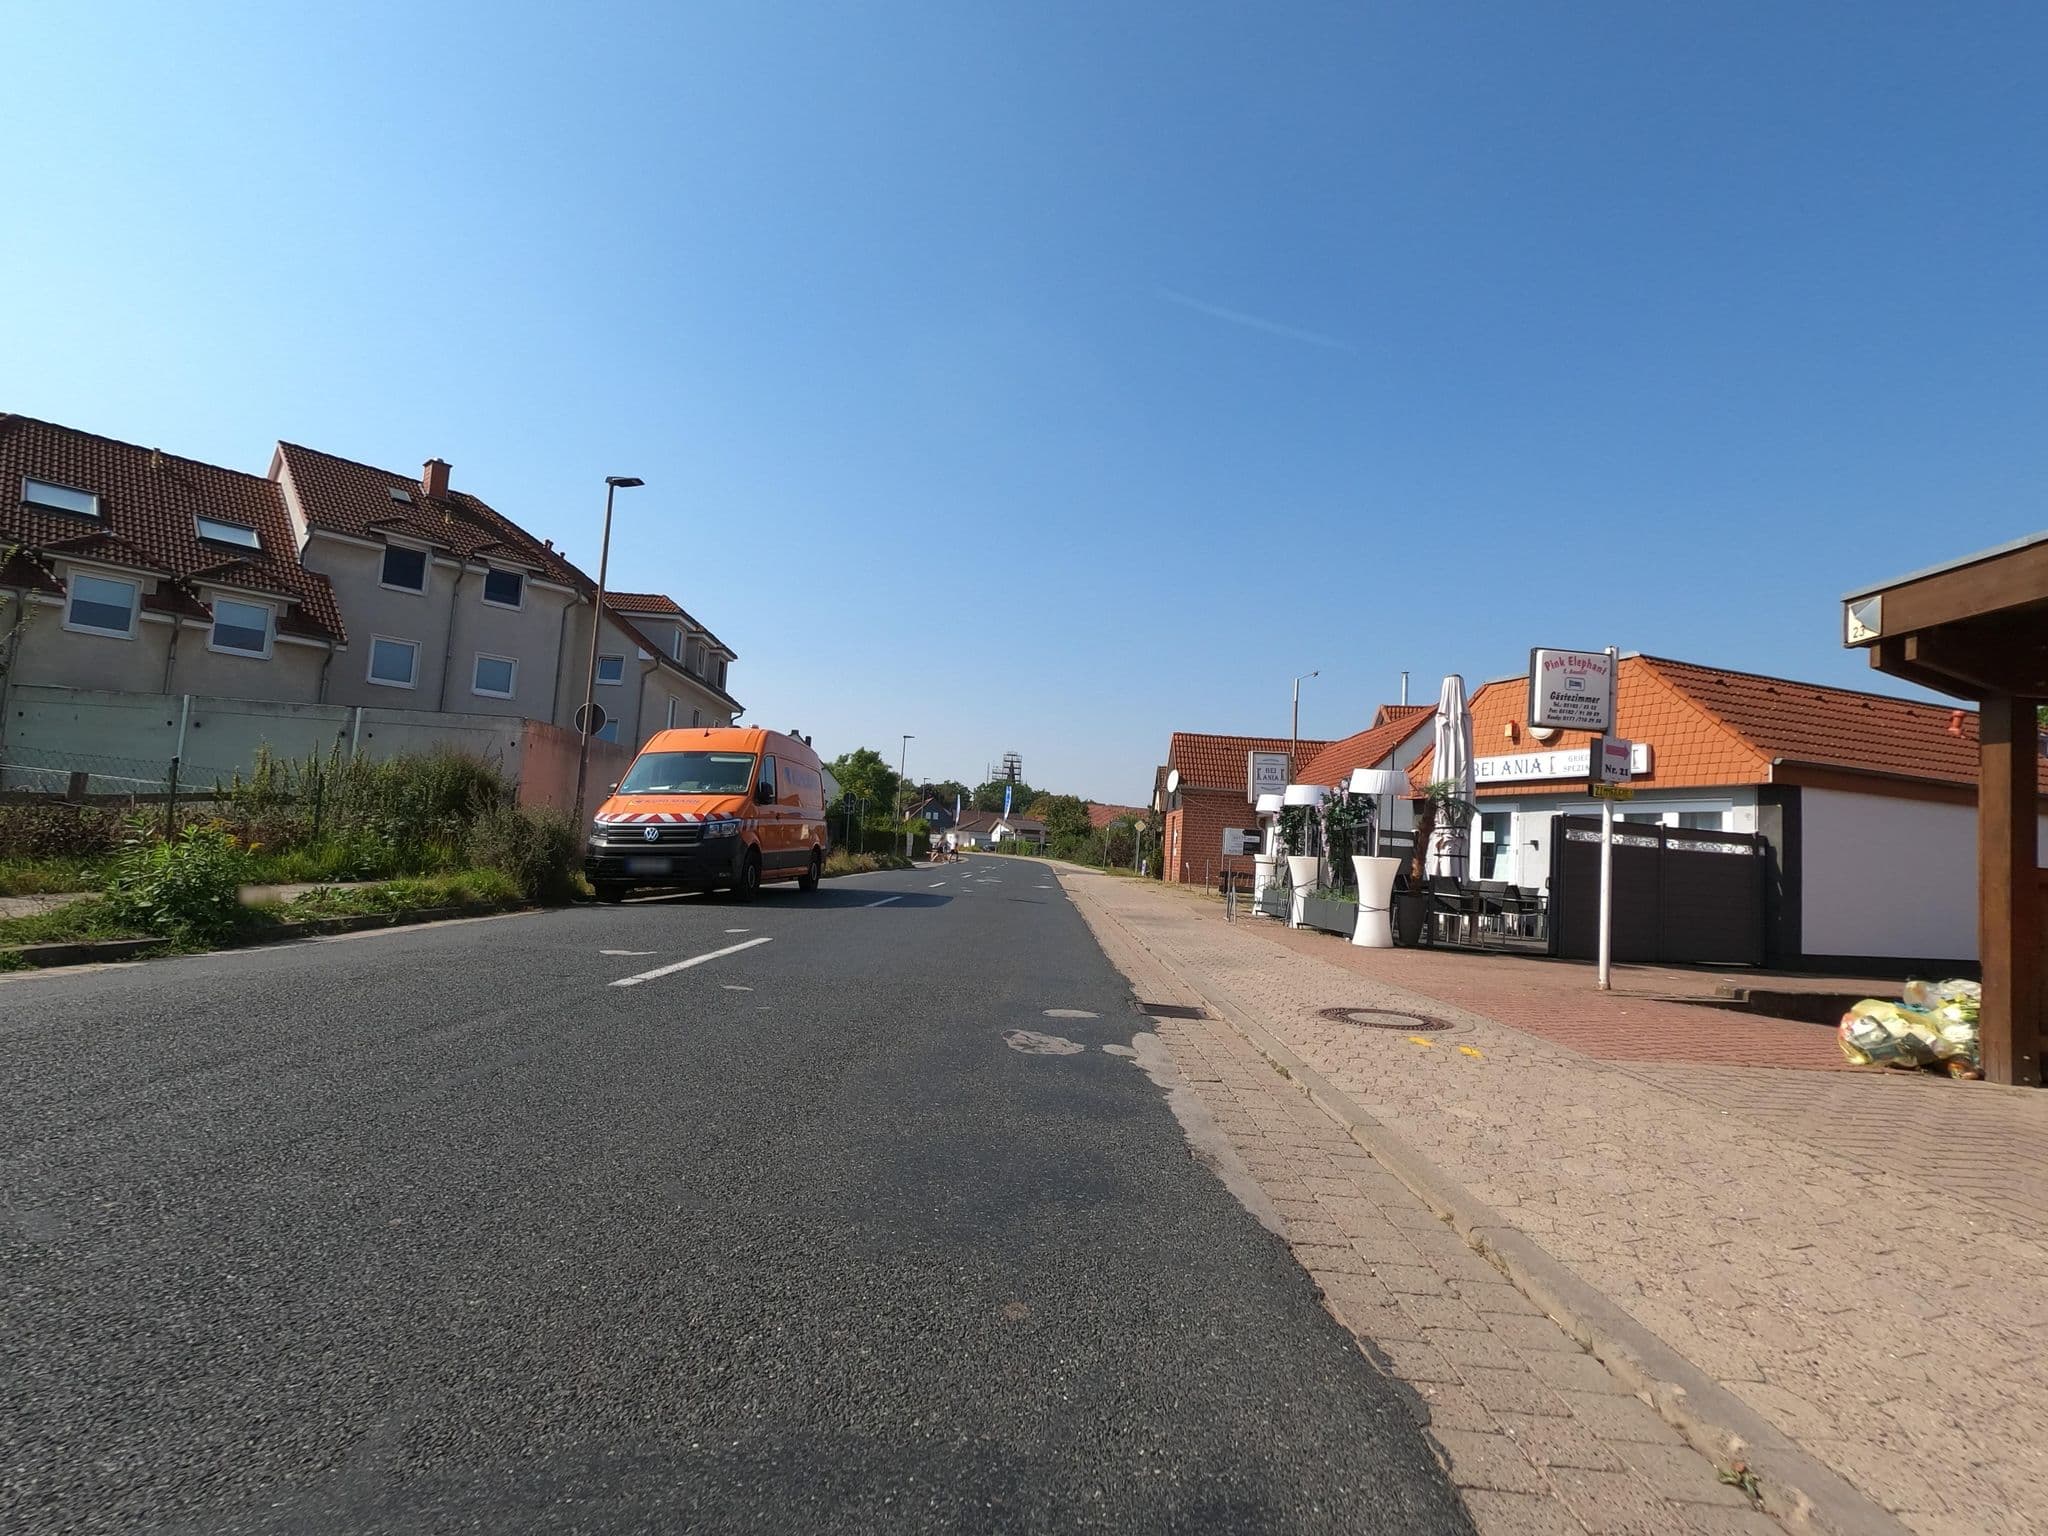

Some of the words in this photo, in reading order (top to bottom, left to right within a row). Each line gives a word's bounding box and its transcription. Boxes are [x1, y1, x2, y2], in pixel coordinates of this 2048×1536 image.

[1853, 625, 1865, 638] 23
[1544, 657, 1566, 671] Pink
[1568, 656, 1607, 675] Elephant
[1550, 691, 1600, 704] Gästezimmer
[1568, 753, 1589, 763] GRIEC
[1474, 762, 1494, 776] BEI
[1501, 758, 1542, 776] ANIA
[1604, 764, 1618, 775] Nr.
[1619, 768, 1629, 776] 21
